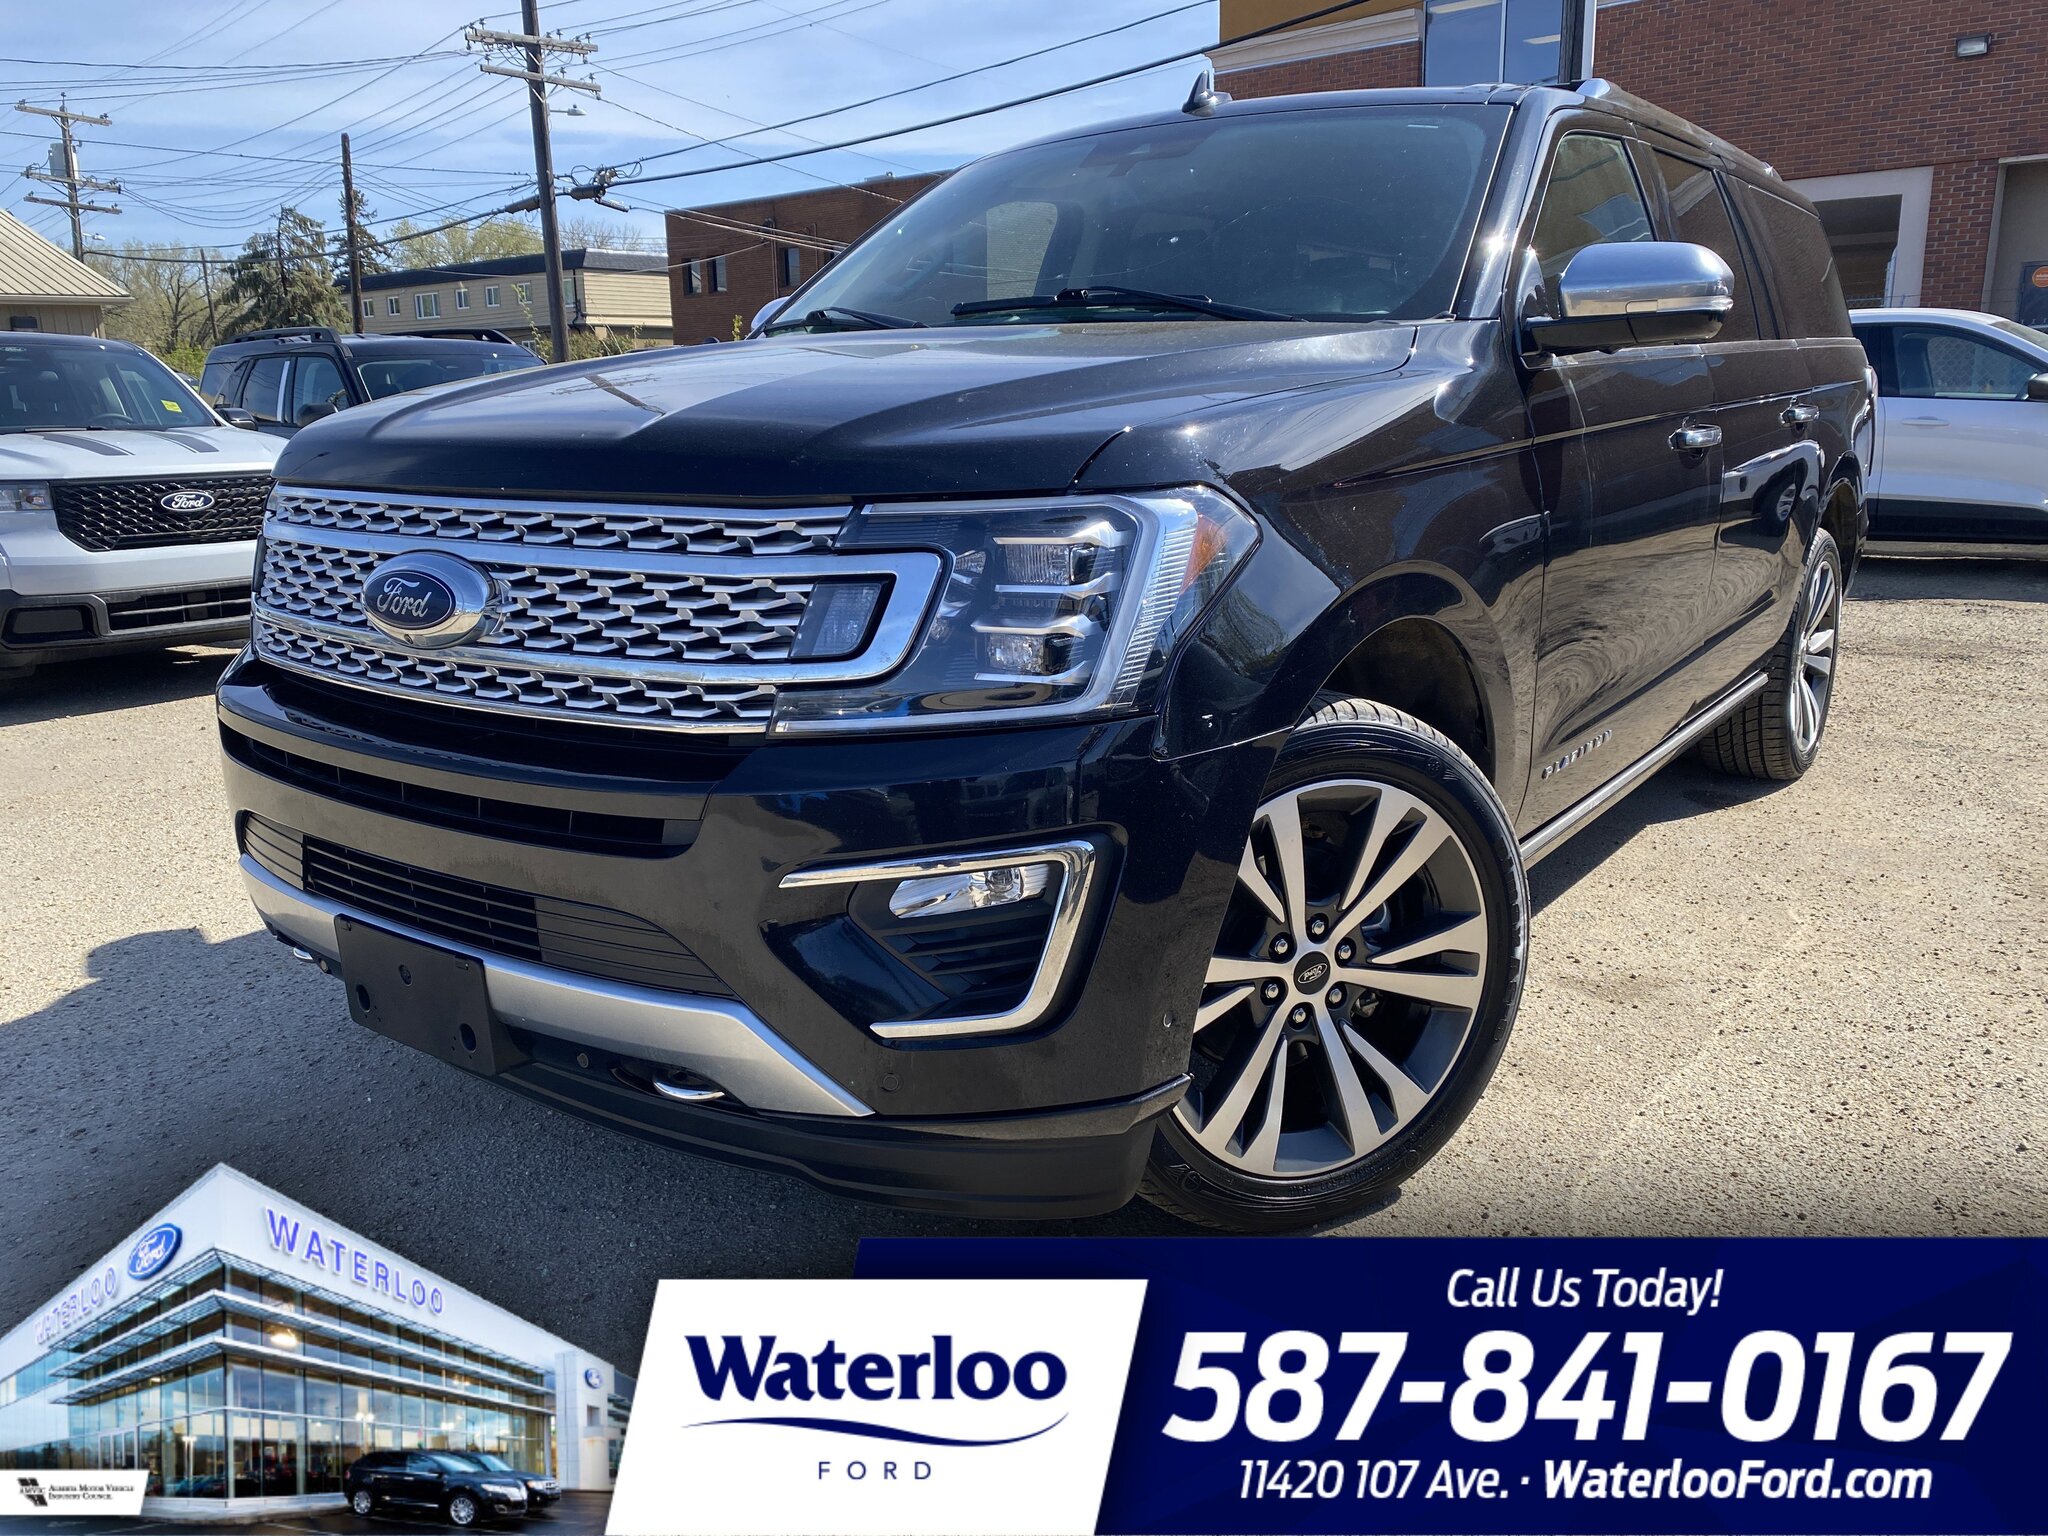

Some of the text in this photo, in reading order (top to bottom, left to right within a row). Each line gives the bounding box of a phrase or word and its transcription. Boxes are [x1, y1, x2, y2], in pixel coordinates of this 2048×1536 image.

[171, 494, 205, 508] Ford
[376, 577, 432, 618] Ford
[1303, 965, 1323, 981] Ford
